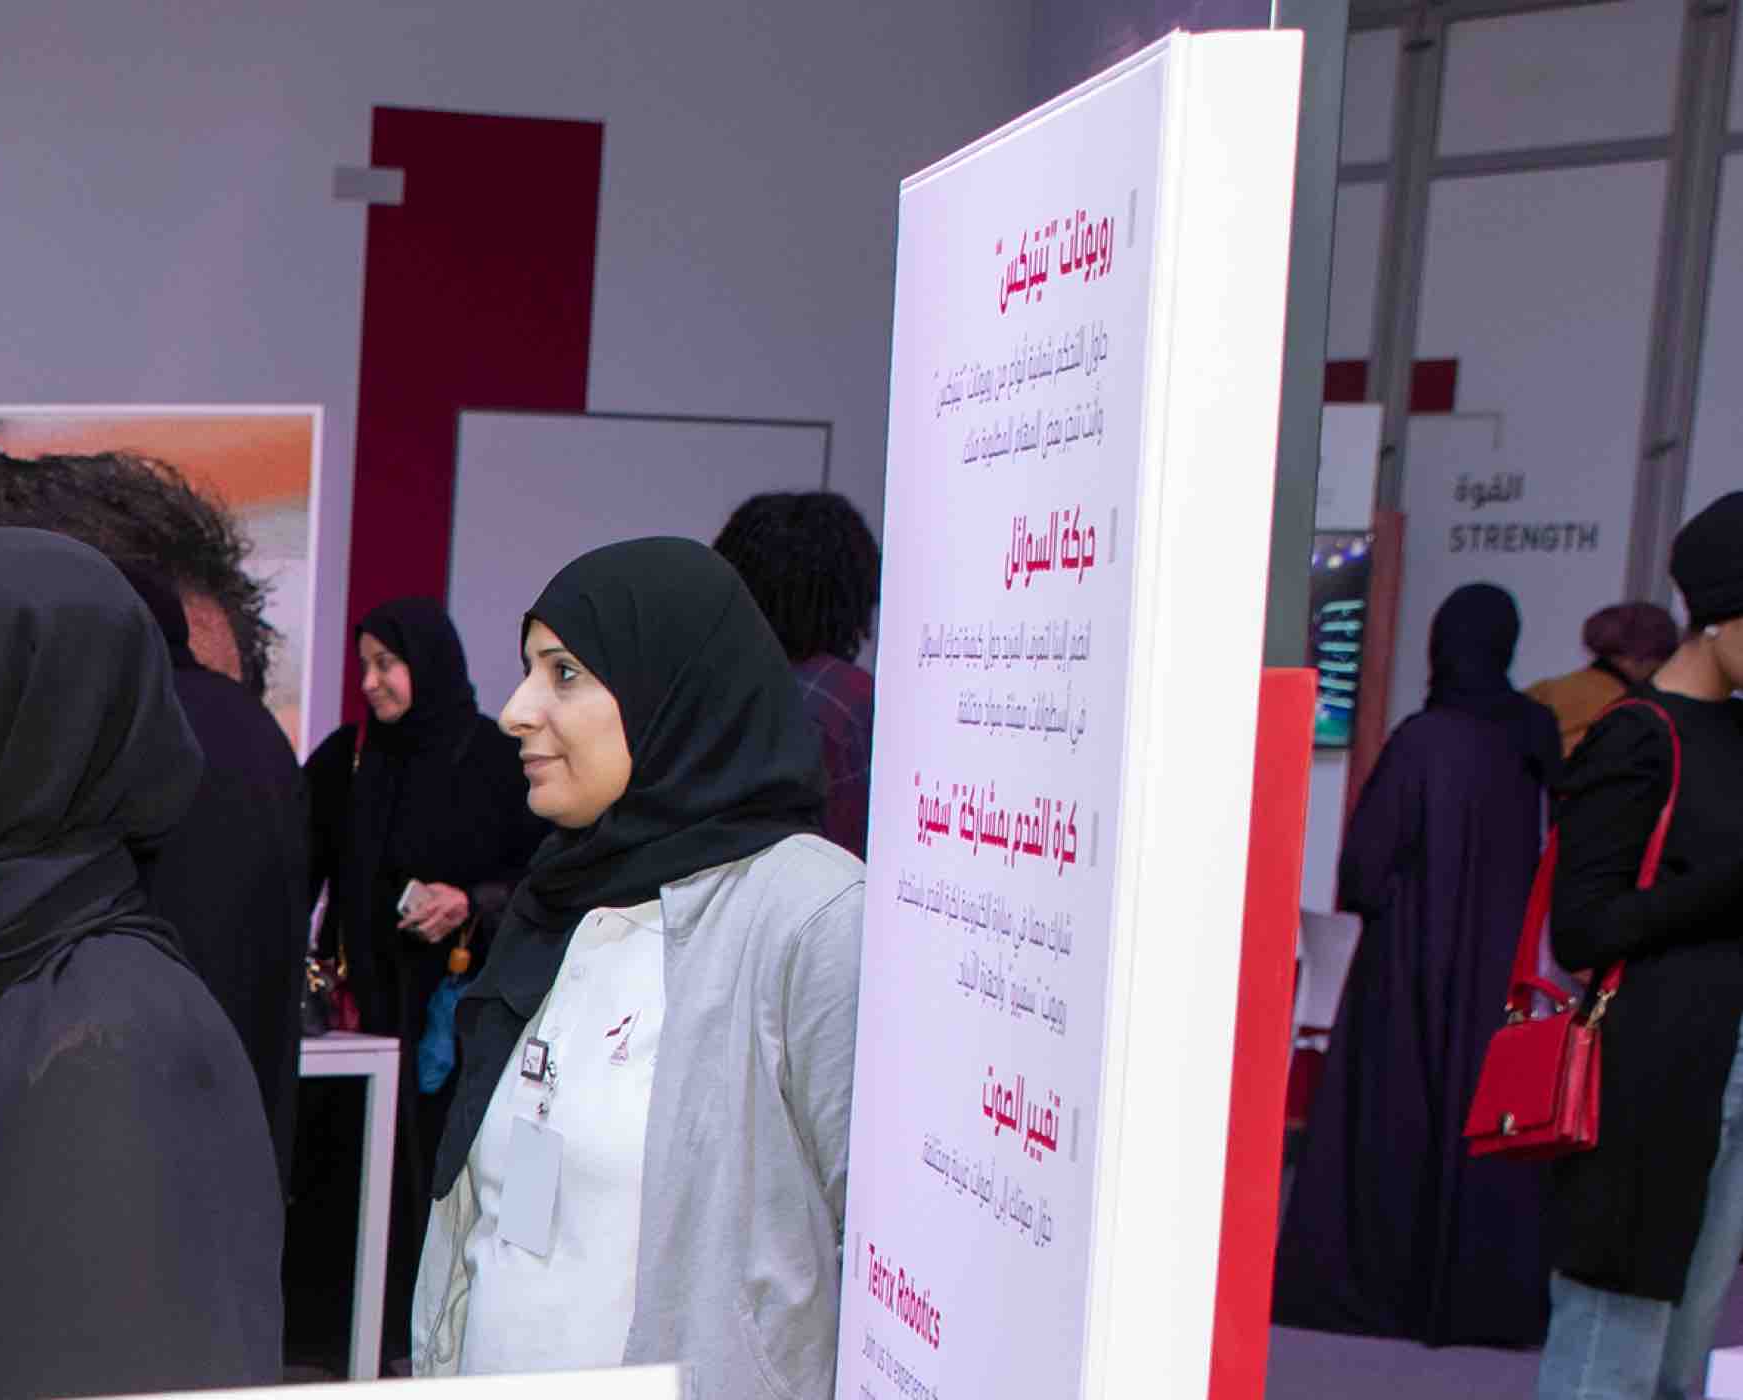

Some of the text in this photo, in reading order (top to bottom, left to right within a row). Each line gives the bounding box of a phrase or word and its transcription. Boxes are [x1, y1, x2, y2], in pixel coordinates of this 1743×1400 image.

[1059, 209, 1115, 283] روبوتات
[1453, 472, 1526, 510] القوة
[1004, 505, 1096, 591] حركة السوائل
[1448, 520, 1601, 553] STRENGTH
[958, 783, 1011, 865] بمشاركة
[1010, 796, 1052, 868] القدم
[1052, 799, 1078, 877] كرة
[982, 1065, 1061, 1163] تغيير الصوت
[867, 1242, 941, 1350] Tetrix Robotics
